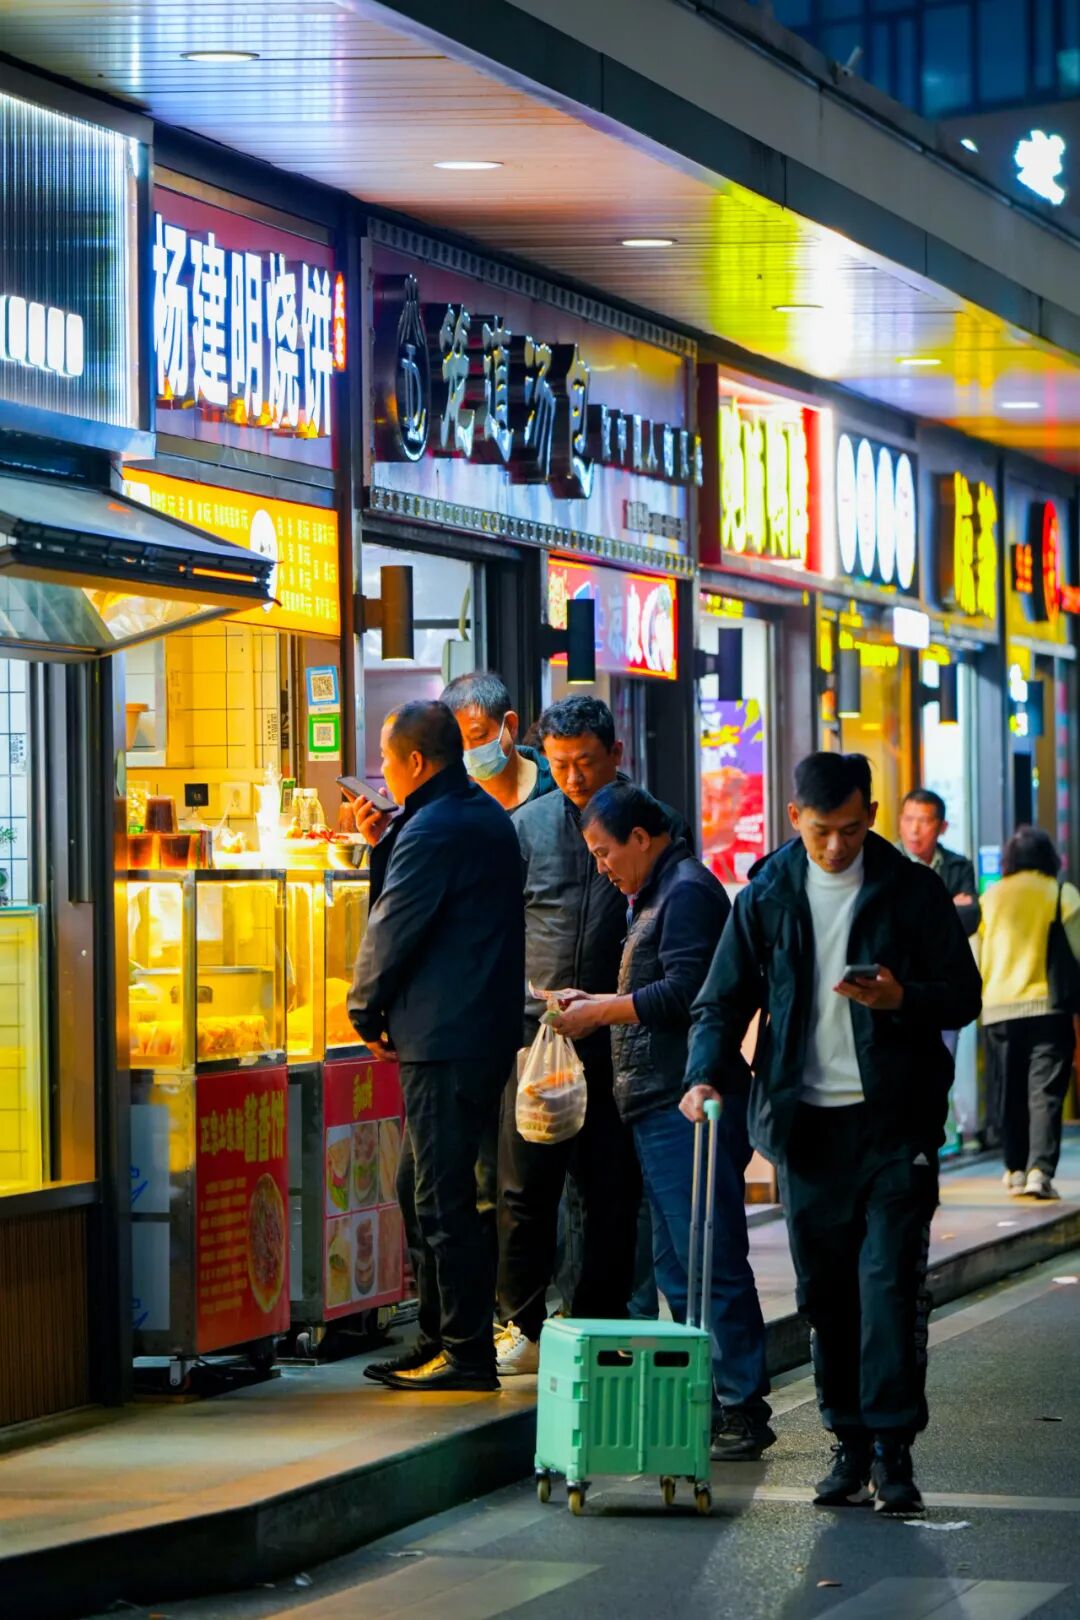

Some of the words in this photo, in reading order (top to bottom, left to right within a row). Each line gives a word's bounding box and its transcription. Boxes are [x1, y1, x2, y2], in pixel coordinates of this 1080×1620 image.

[153, 212, 333, 437] 杨建明烧饼
